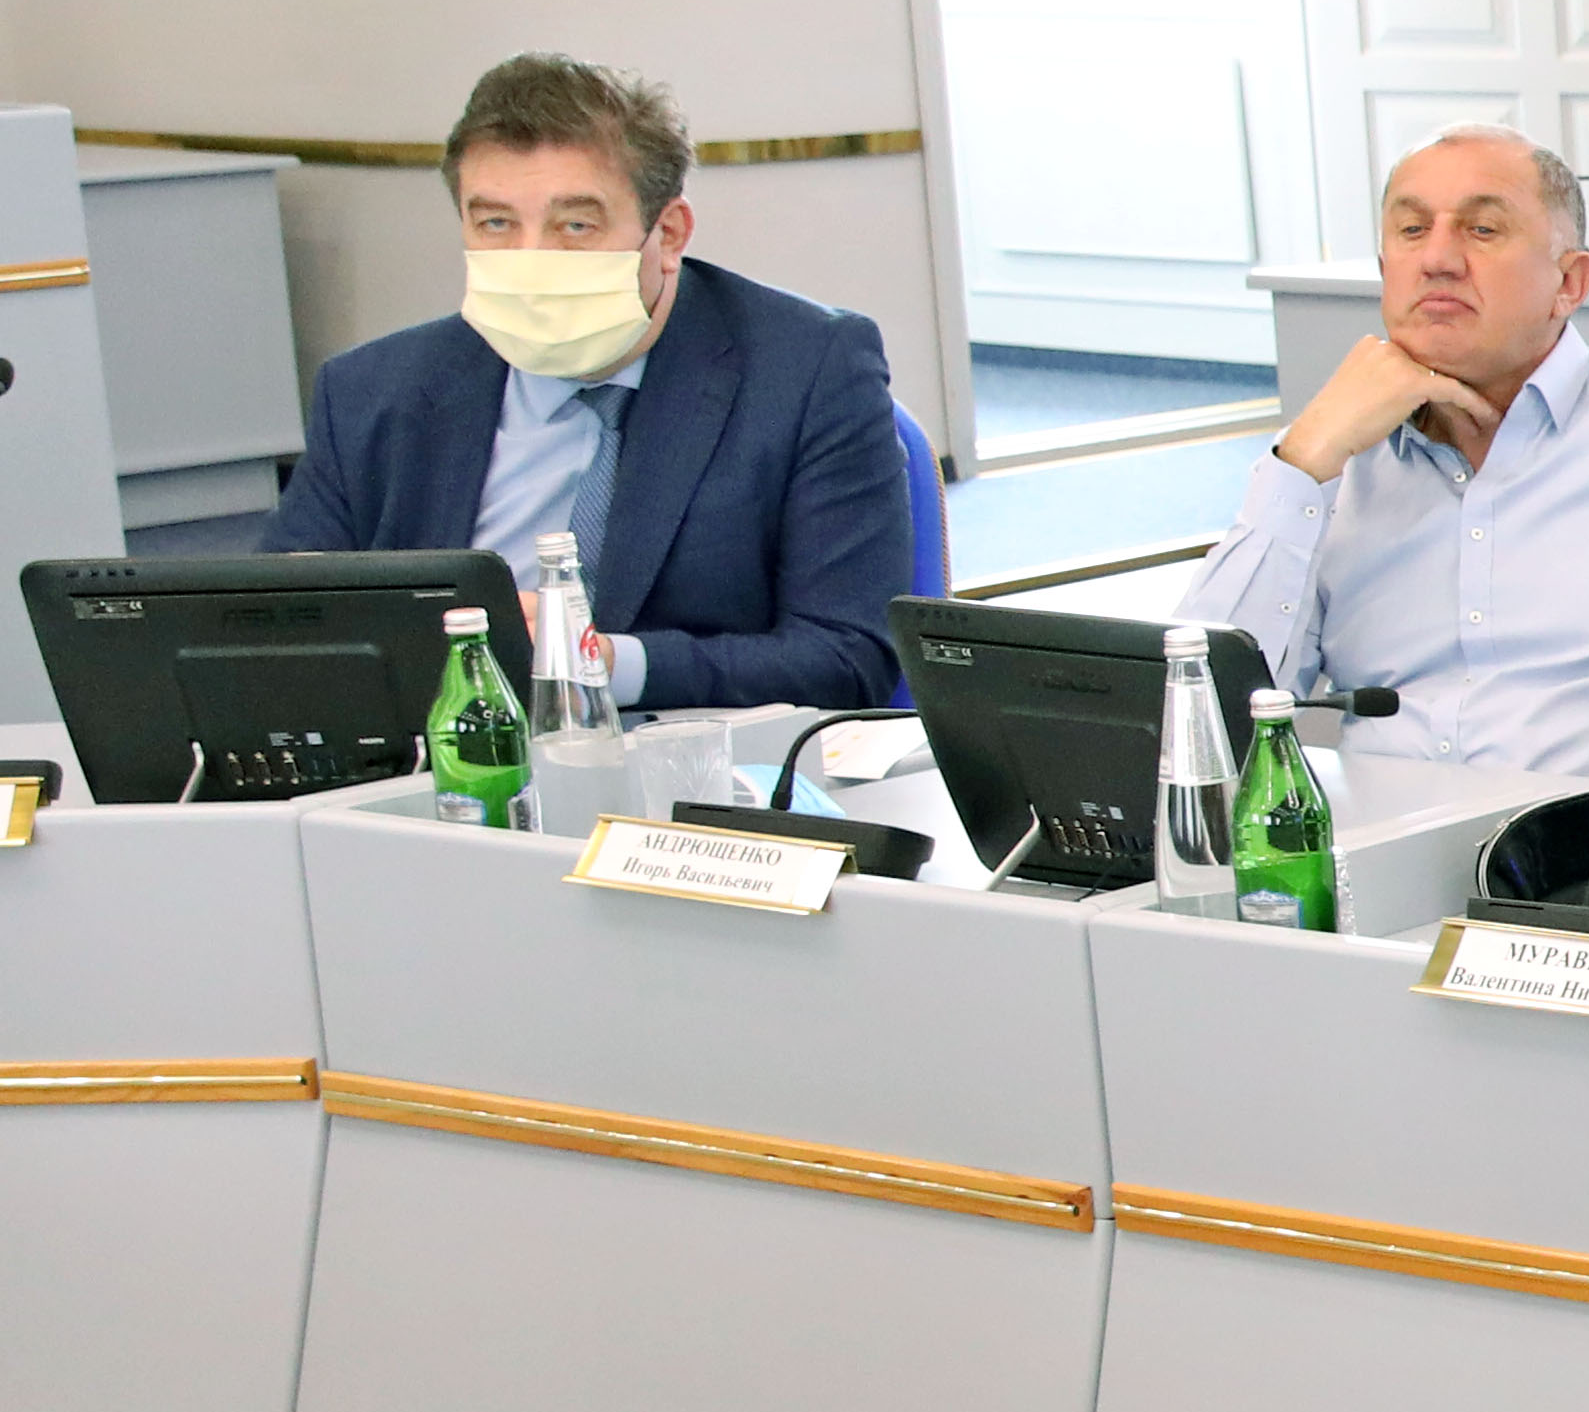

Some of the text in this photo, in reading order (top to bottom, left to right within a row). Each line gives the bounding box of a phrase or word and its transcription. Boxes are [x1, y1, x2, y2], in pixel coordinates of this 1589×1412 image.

[639, 833, 782, 867] АНДРЮЩЕНКО
[622, 856, 774, 893] Игорь Васильевич
[1450, 967, 1555, 996] Валентина
